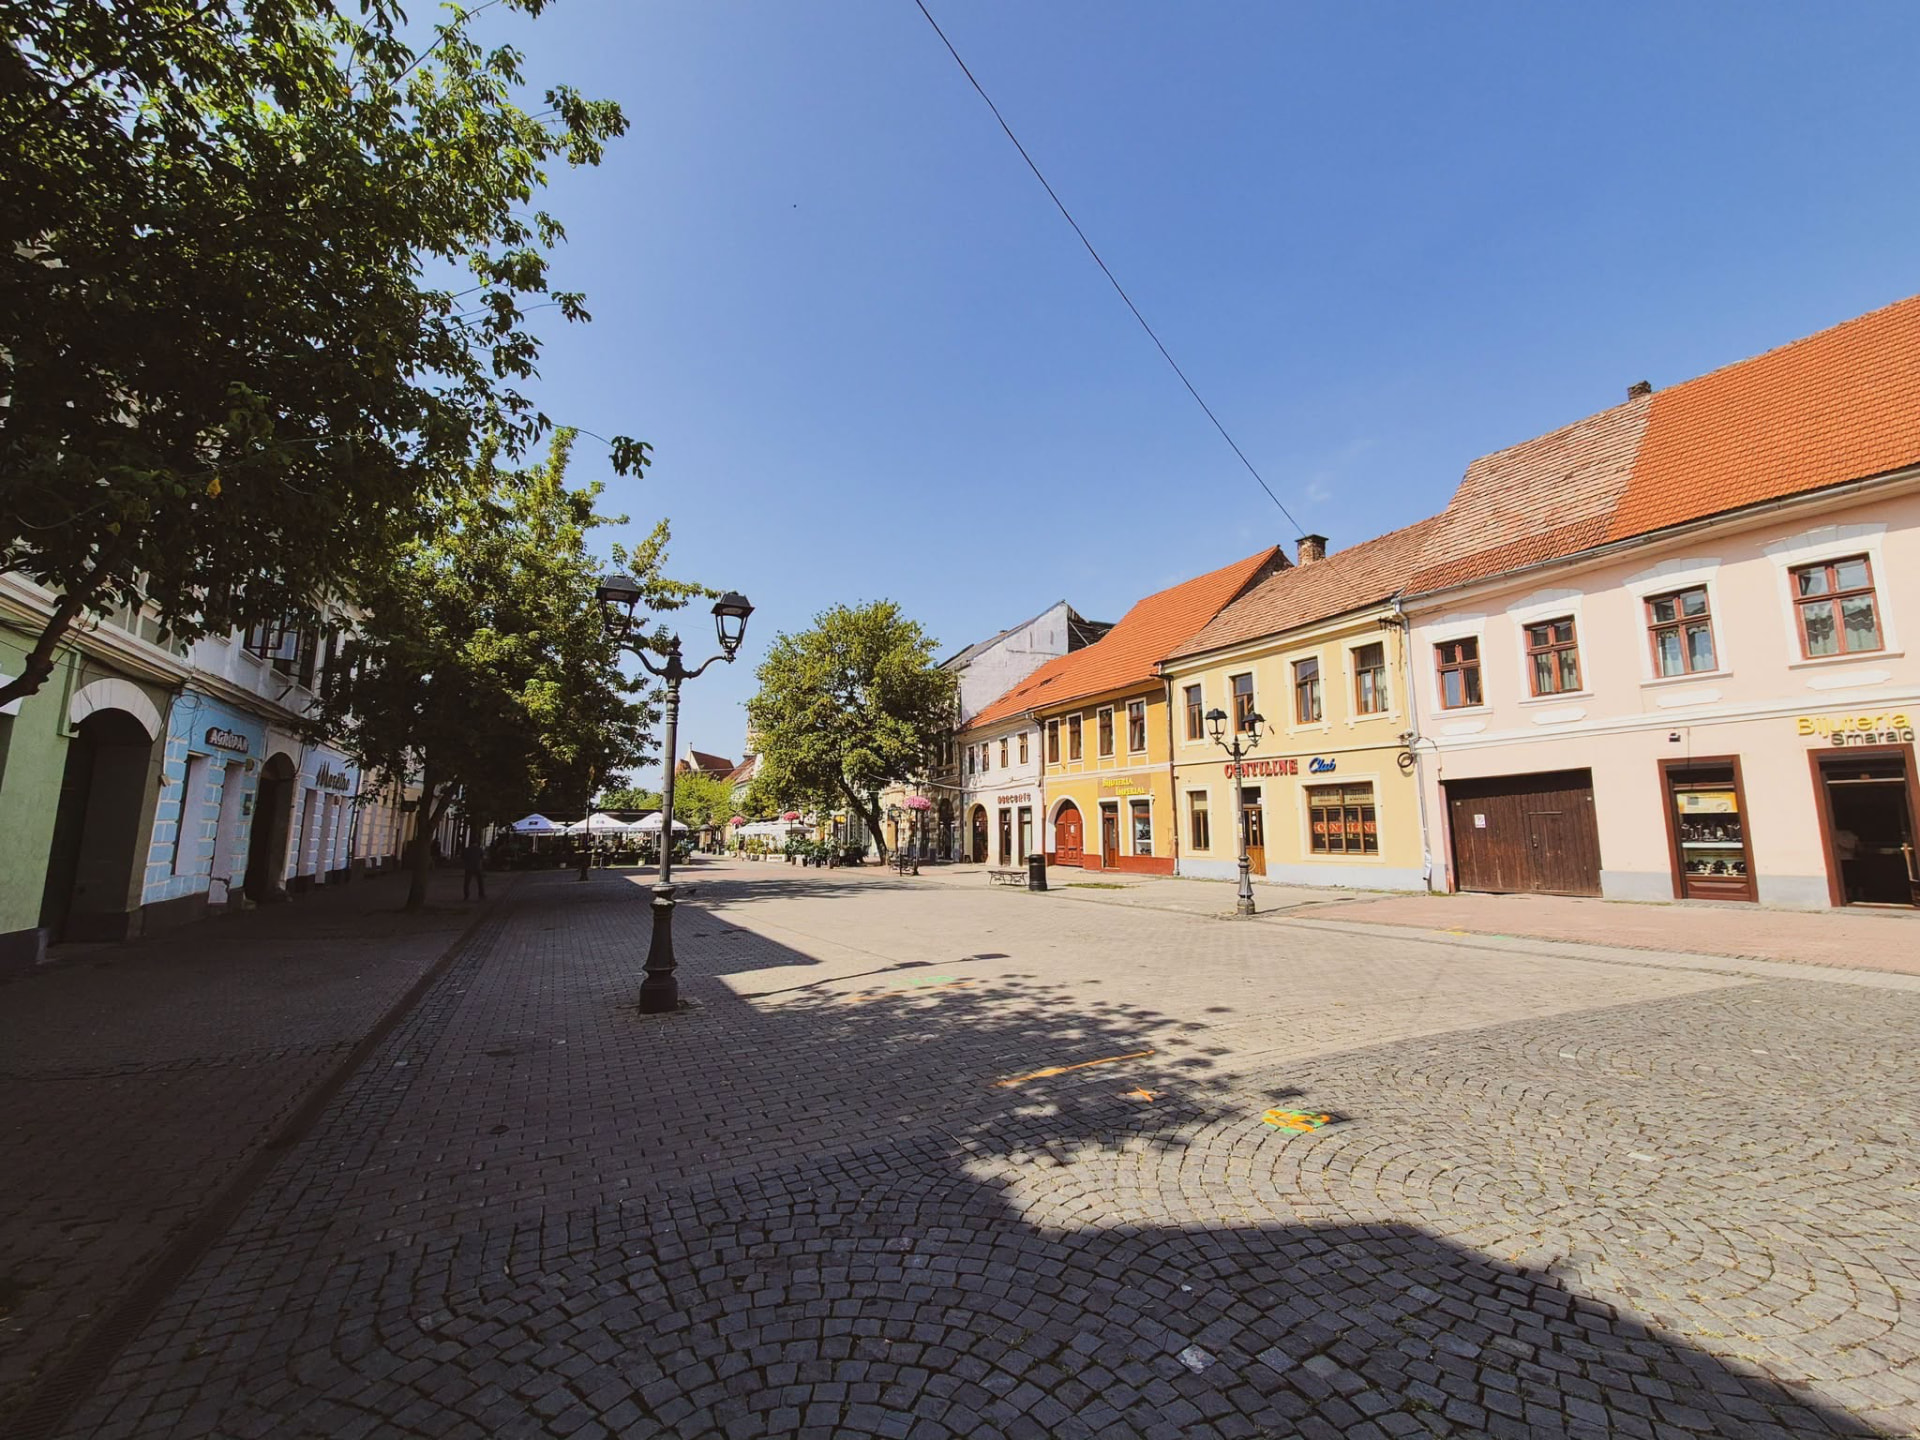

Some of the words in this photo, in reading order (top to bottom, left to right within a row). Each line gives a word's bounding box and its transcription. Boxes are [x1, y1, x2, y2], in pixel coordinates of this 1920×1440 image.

[1797, 713, 1910, 739] Bijuteria
[1831, 727, 1915, 746] Smarald
[1309, 757, 1337, 774] Club
